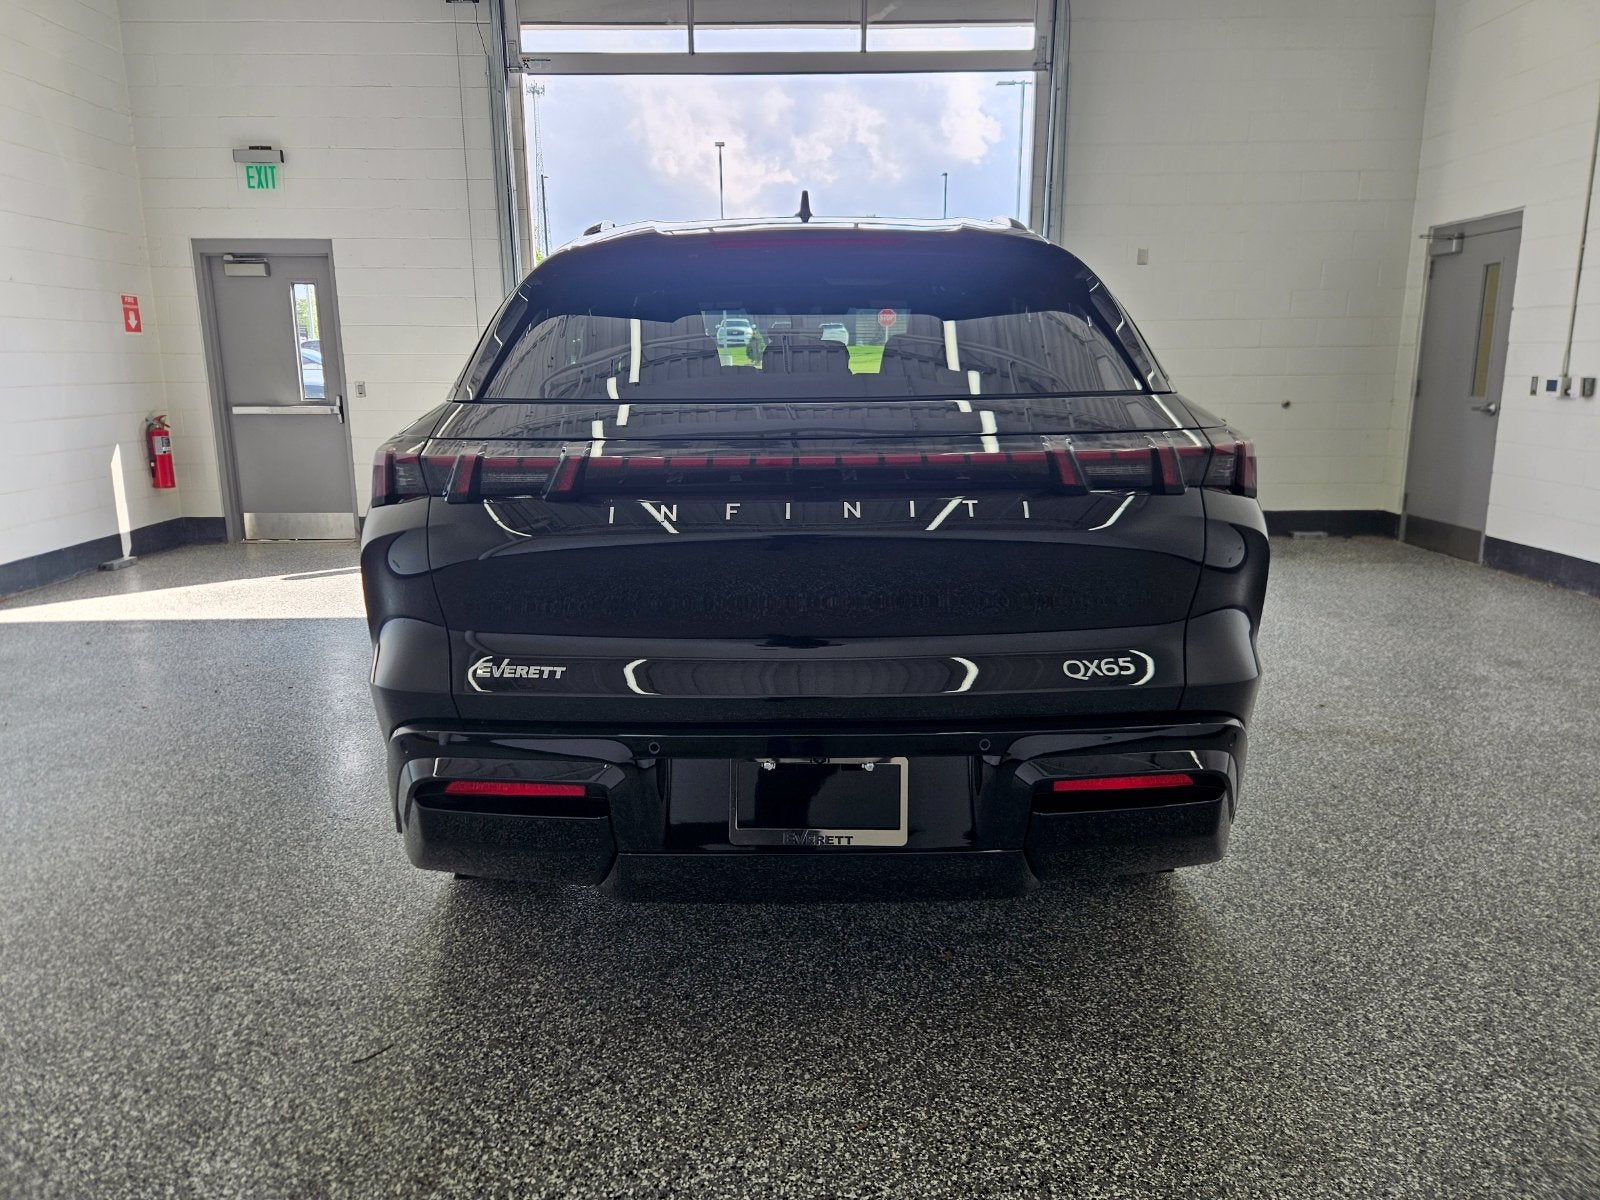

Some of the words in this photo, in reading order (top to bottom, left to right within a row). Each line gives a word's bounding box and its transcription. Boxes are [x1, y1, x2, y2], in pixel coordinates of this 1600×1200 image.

[245, 165, 276, 189] EXIT
[608, 500, 1030, 524] INFINITI
[475, 658, 567, 679] EVERETT
[1062, 657, 1136, 680] QX65
